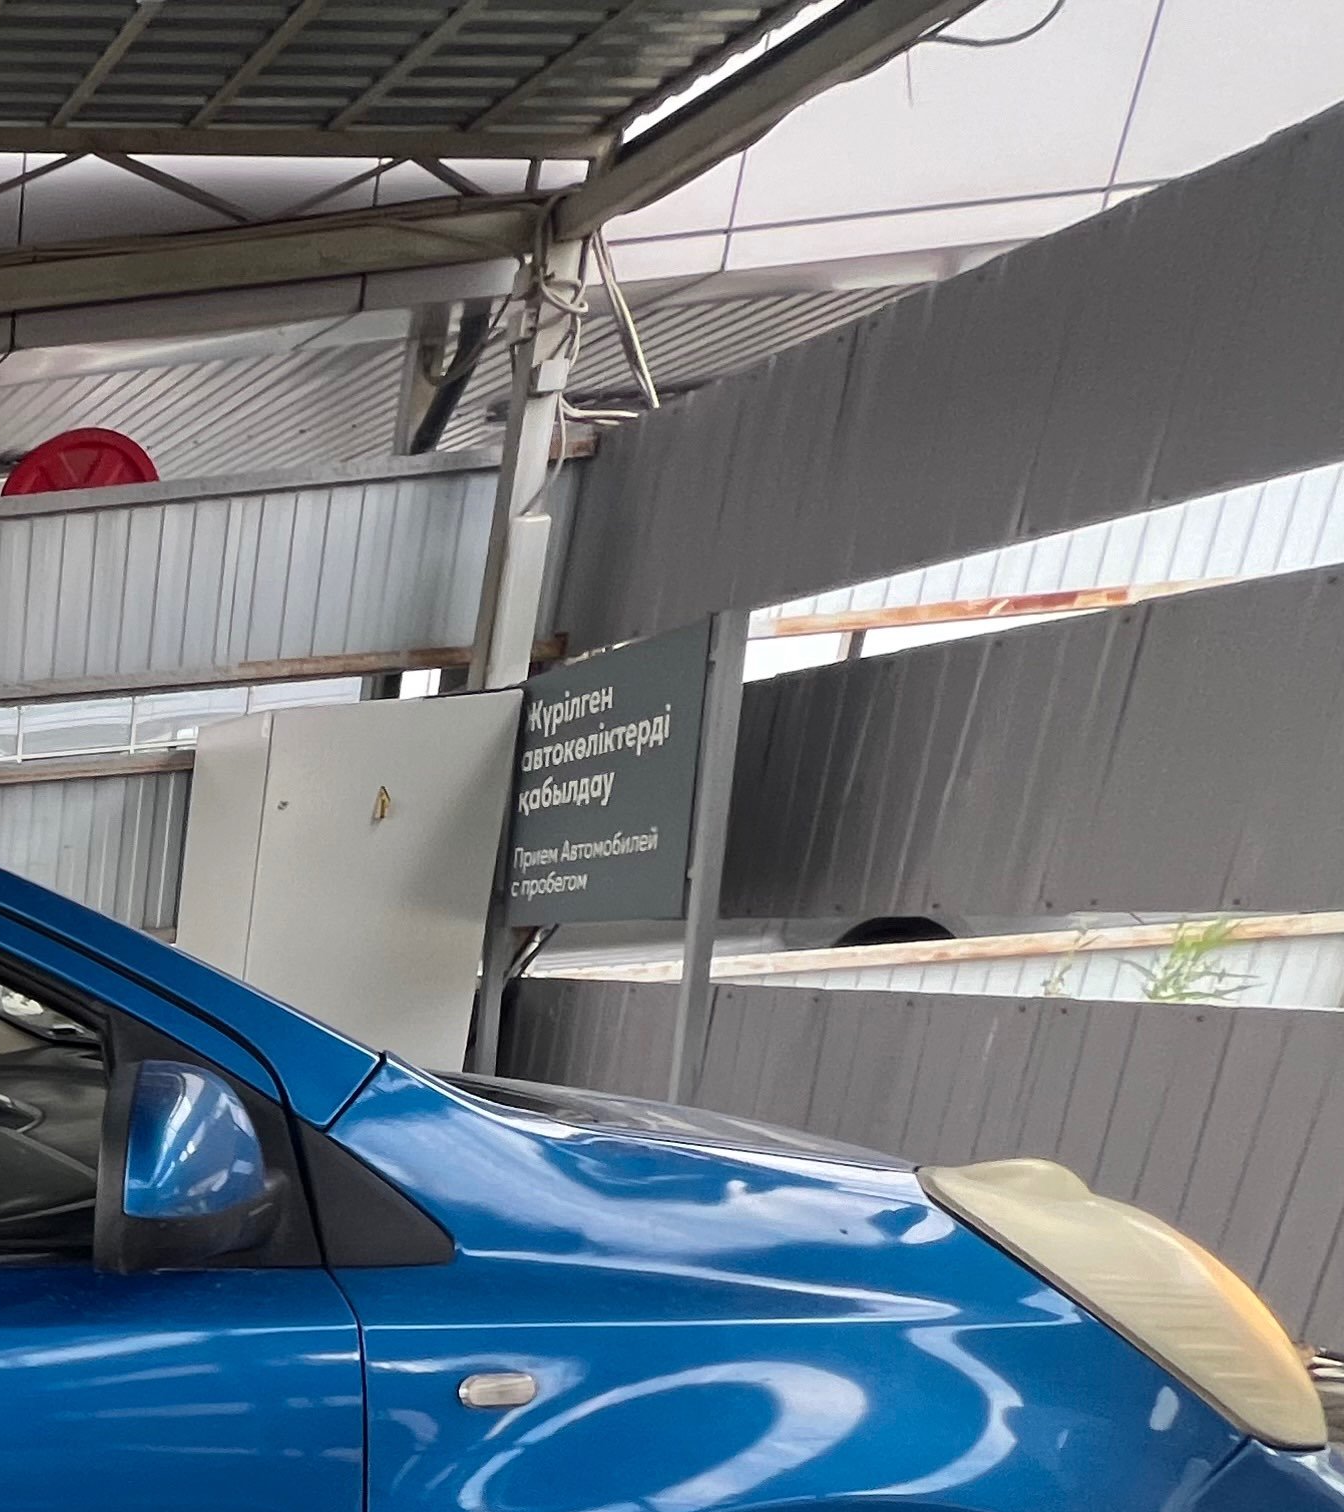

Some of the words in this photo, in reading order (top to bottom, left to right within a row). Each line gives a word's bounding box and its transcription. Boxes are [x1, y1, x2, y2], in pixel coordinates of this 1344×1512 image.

[520, 703, 673, 773] автокөліктерді
[518, 771, 616, 816] қабылдау
[513, 847, 559, 874] Прием
[560, 826, 659, 863] Автомобилей
[510, 878, 520, 897] с
[520, 871, 588, 901] пробегом
